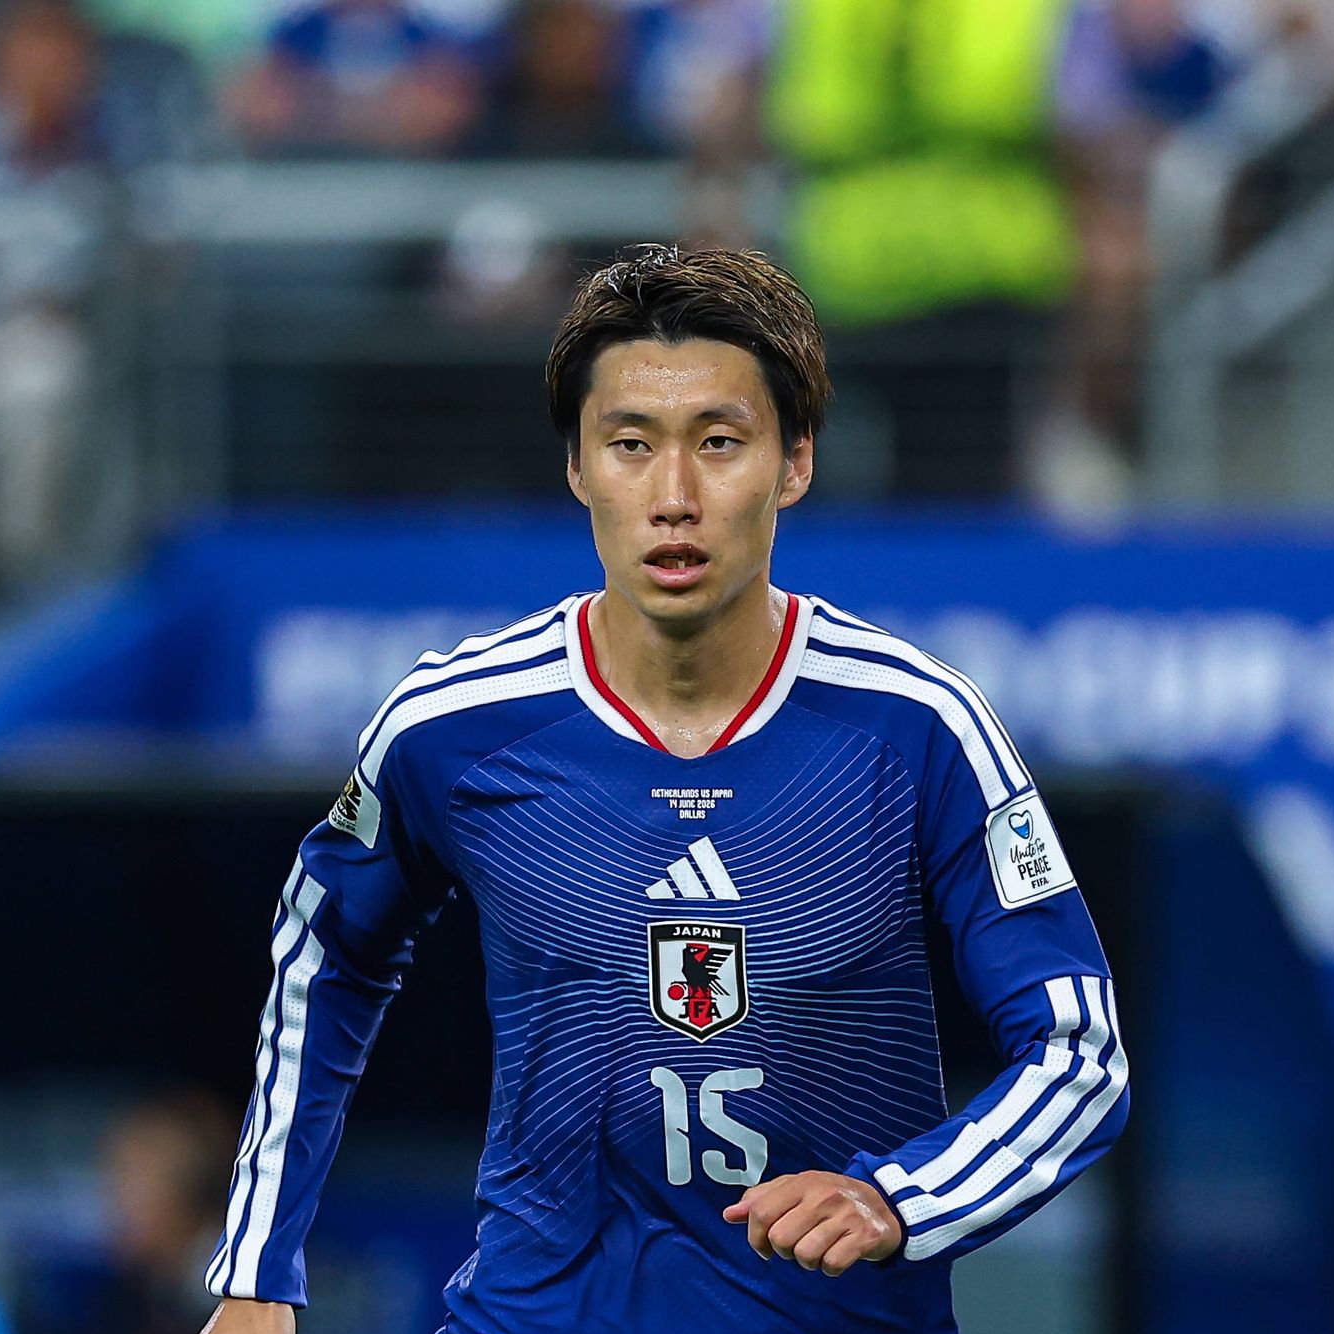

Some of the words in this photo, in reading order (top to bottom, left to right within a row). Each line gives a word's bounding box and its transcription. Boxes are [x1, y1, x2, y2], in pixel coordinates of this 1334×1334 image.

[651, 788, 699, 798] NETHERLANDS
[711, 788, 733, 798] JAPAN
[669, 799, 677, 808] 14
[679, 799, 695, 808] JUNE
[697, 799, 715, 808] 2026
[679, 810, 706, 819] DALLAS
[1010, 843, 1036, 863] Unite
[1017, 855, 1052, 880] PEACE
[1031, 876, 1049, 889] FIFA
[672, 926, 721, 939] JAPAN
[678, 1001, 722, 1019] JFA
[650, 1066, 768, 1187] 15
